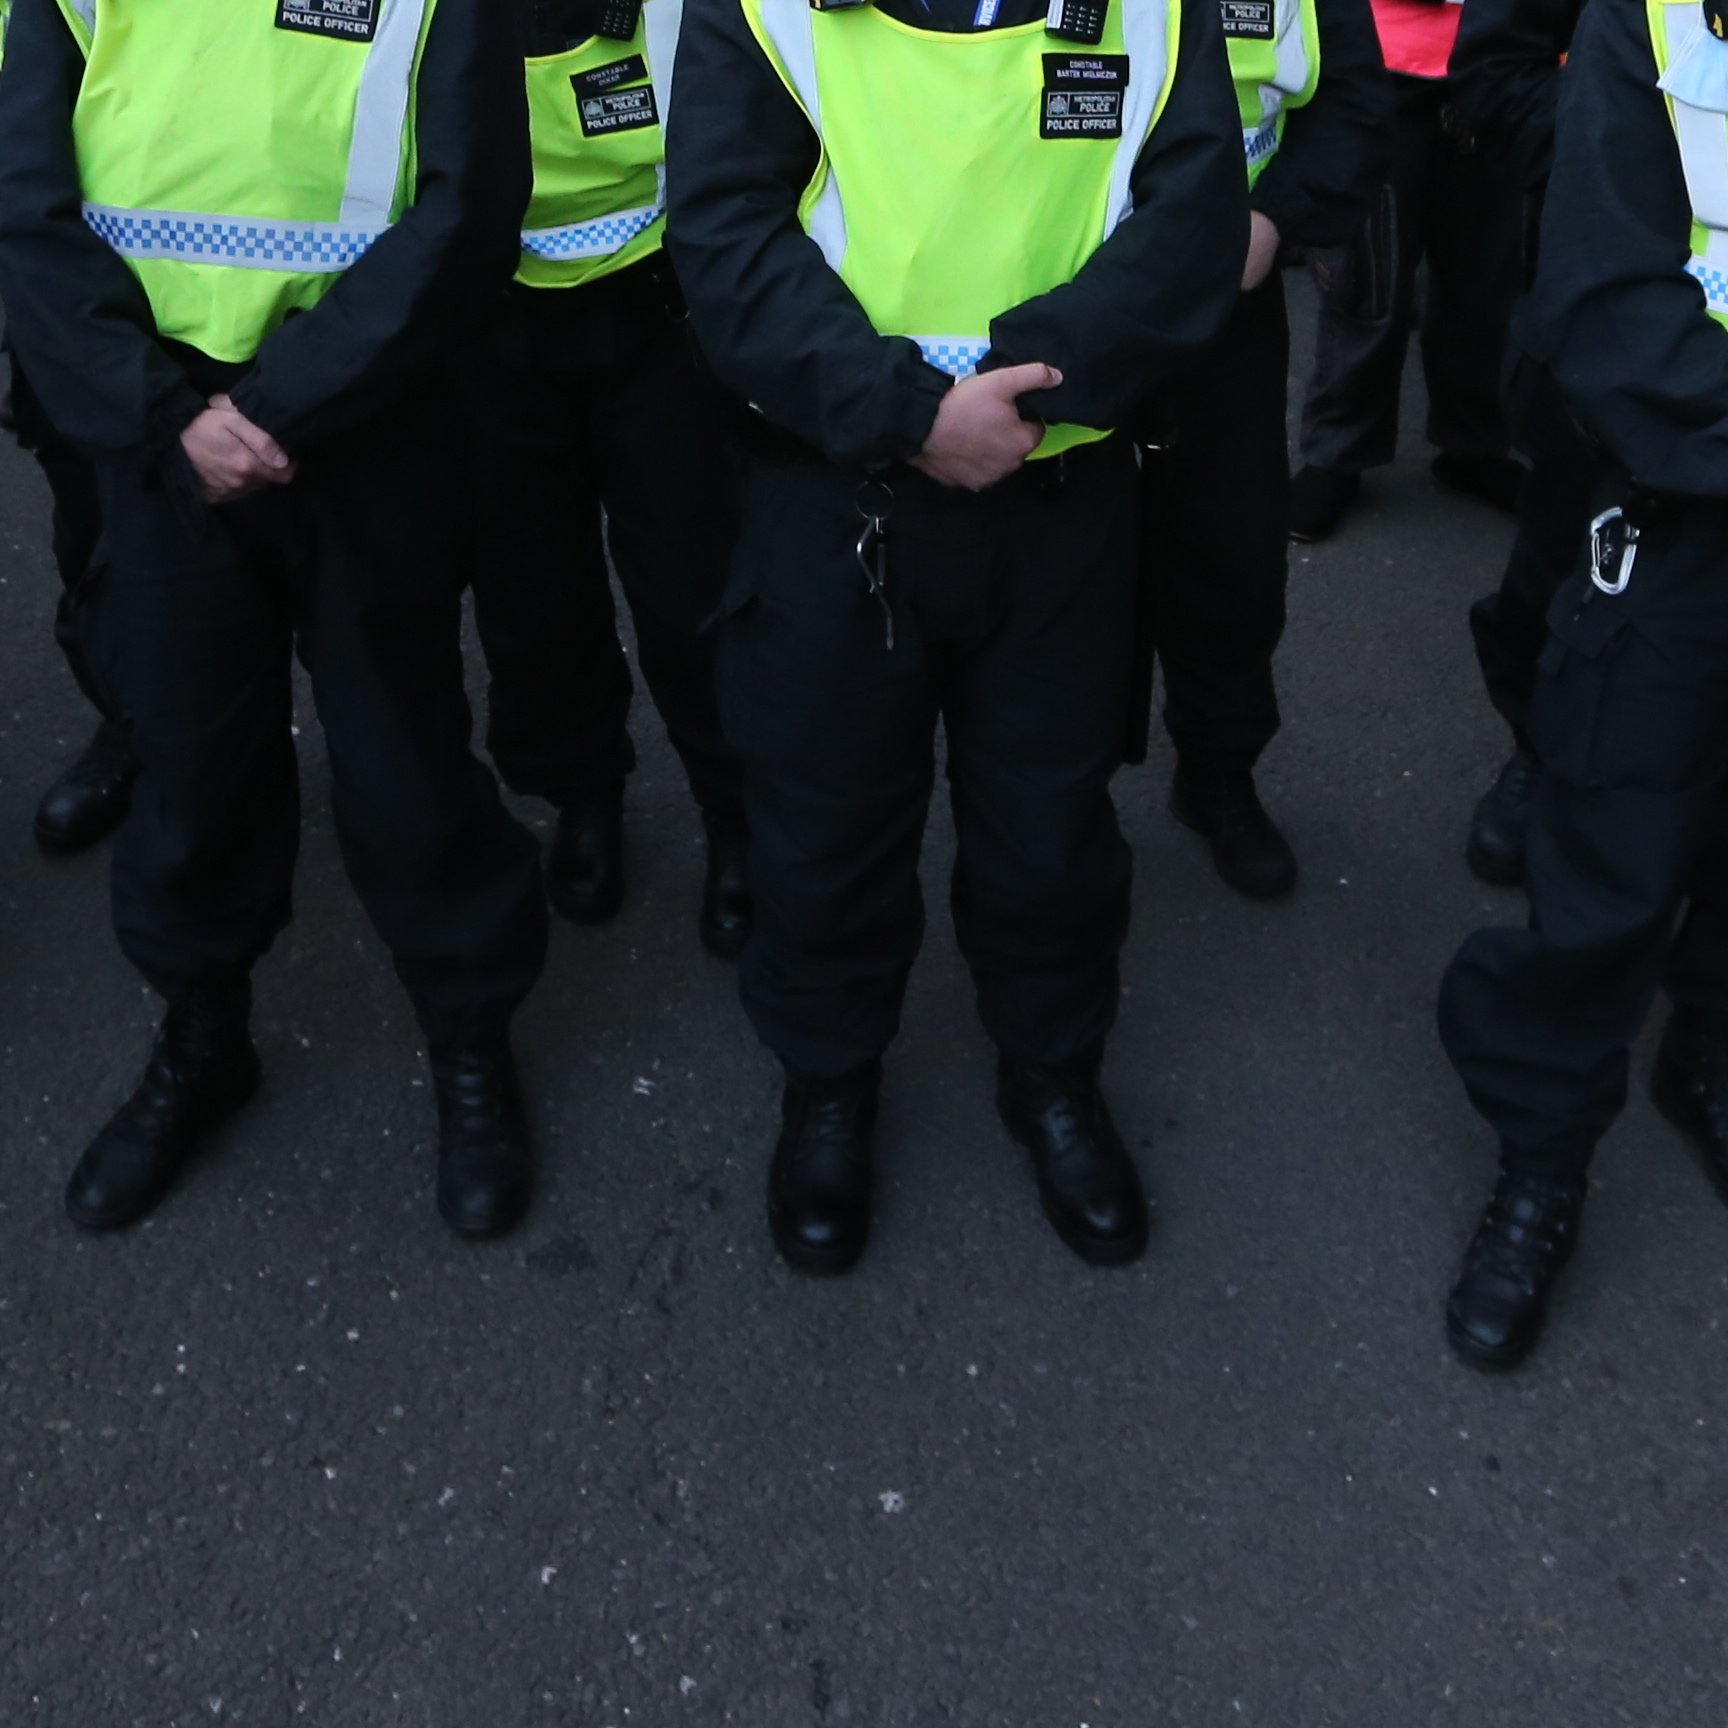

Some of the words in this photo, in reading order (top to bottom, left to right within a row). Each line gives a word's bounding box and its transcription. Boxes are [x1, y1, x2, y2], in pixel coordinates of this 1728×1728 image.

[322, 0, 360, 17] POLICE
[1234, 9, 1261, 20] POLICE
[282, 10, 322, 29] POLICE
[323, 16, 370, 35] OFFICER
[1237, 22, 1270, 34] OFFICER
[1069, 60, 1103, 70] CONSTABLE
[585, 63, 630, 83] CONSTABLE
[612, 97, 642, 111] POLICE
[1079, 103, 1111, 113] POLICE
[586, 114, 618, 130] POLICE
[617, 109, 653, 124] OFFICER
[1046, 118, 1081, 131] POLICE
[1081, 117, 1118, 130] OFFICER
